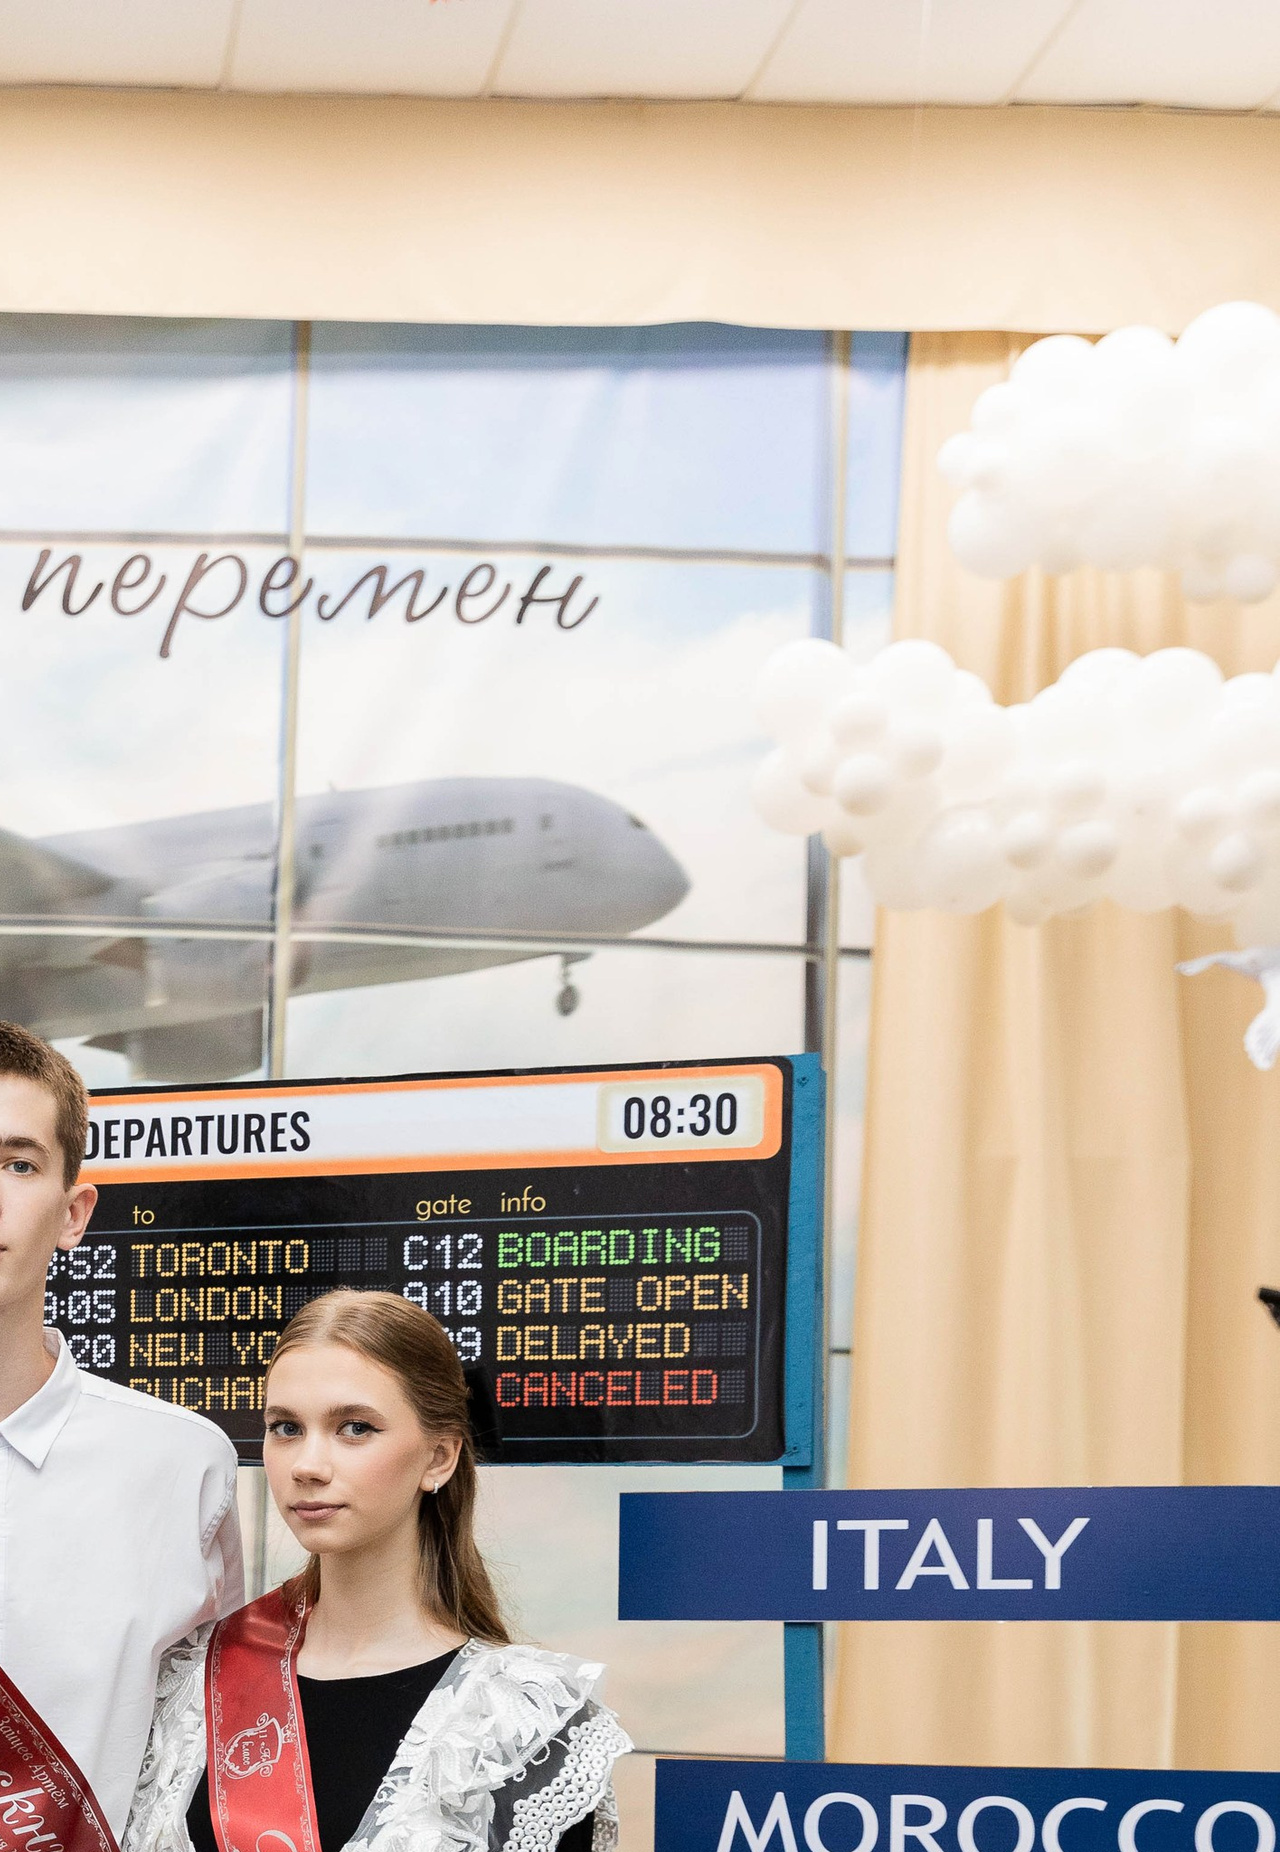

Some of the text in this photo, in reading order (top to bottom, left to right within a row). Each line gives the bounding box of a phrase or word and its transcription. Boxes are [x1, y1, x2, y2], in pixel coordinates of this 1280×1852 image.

[21, 547, 600, 659] перемен
[84, 1110, 312, 1161] DEPARTURES
[623, 1092, 737, 1139] 08:30
[132, 1186, 546, 1225] to gate info
[131, 1239, 309, 1278] TORONTO
[403, 1233, 483, 1271] C12
[498, 1226, 721, 1269] BOARDING
[130, 1285, 283, 1322] LONDON
[497, 1277, 606, 1316] GATE
[636, 1273, 749, 1312] OPEN
[130, 1332, 204, 1367] NEW
[496, 1321, 691, 1361] DELAYED
[495, 1368, 718, 1408] CANCELED
[812, 1517, 1091, 1591] ITALY
[28, 1763, 70, 1809] Артём
